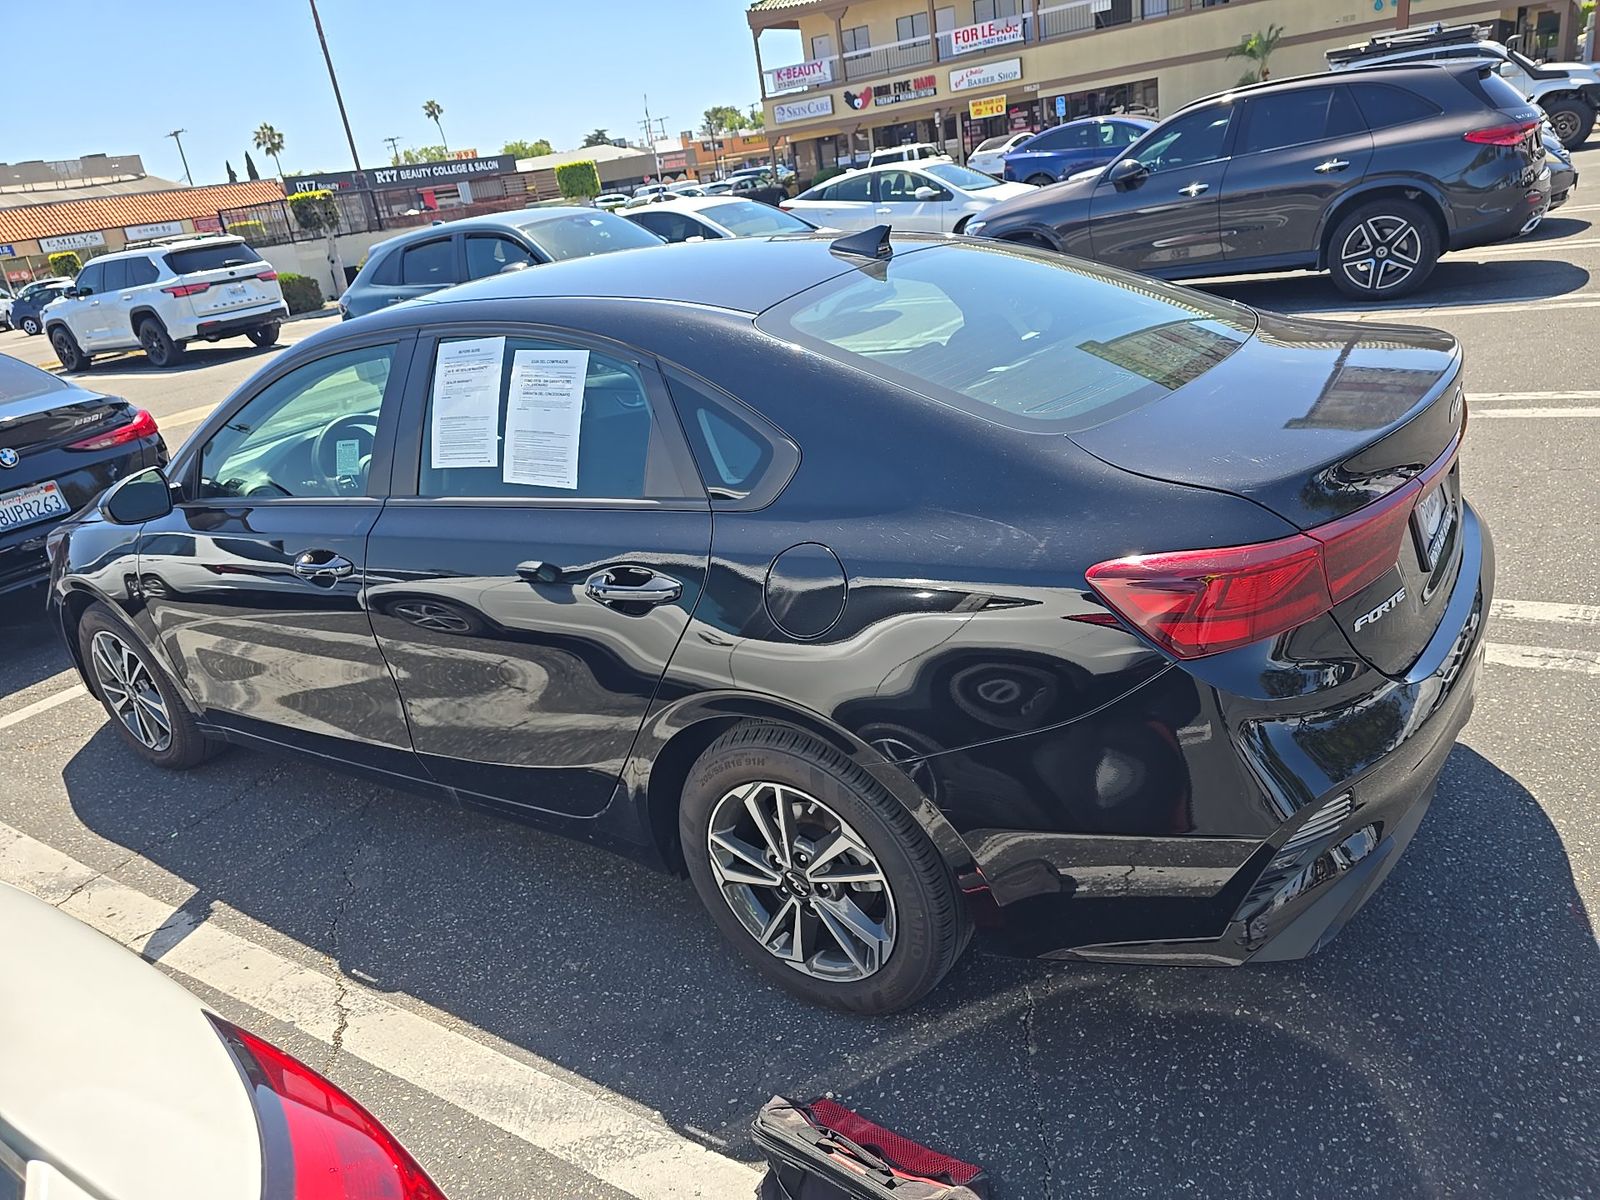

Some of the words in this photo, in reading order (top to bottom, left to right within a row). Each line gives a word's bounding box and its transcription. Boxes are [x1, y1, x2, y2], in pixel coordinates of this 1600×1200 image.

[954, 27, 978, 45] FOR
[776, 60, 823, 82] K-BEAUTY
[967, 75, 995, 88] BARBER
[997, 71, 1018, 82] SHOP
[893, 79, 912, 94] FIVE
[374, 169, 398, 184] RT7
[400, 167, 432, 180] BEAUTY
[432, 163, 468, 177] COLLEGE
[468, 163, 475, 172] &
[475, 159, 499, 171] SALON
[296, 180, 316, 193] RT7
[0, 494, 62, 526] 8UPR263
[1354, 586, 1406, 633] FORTE
